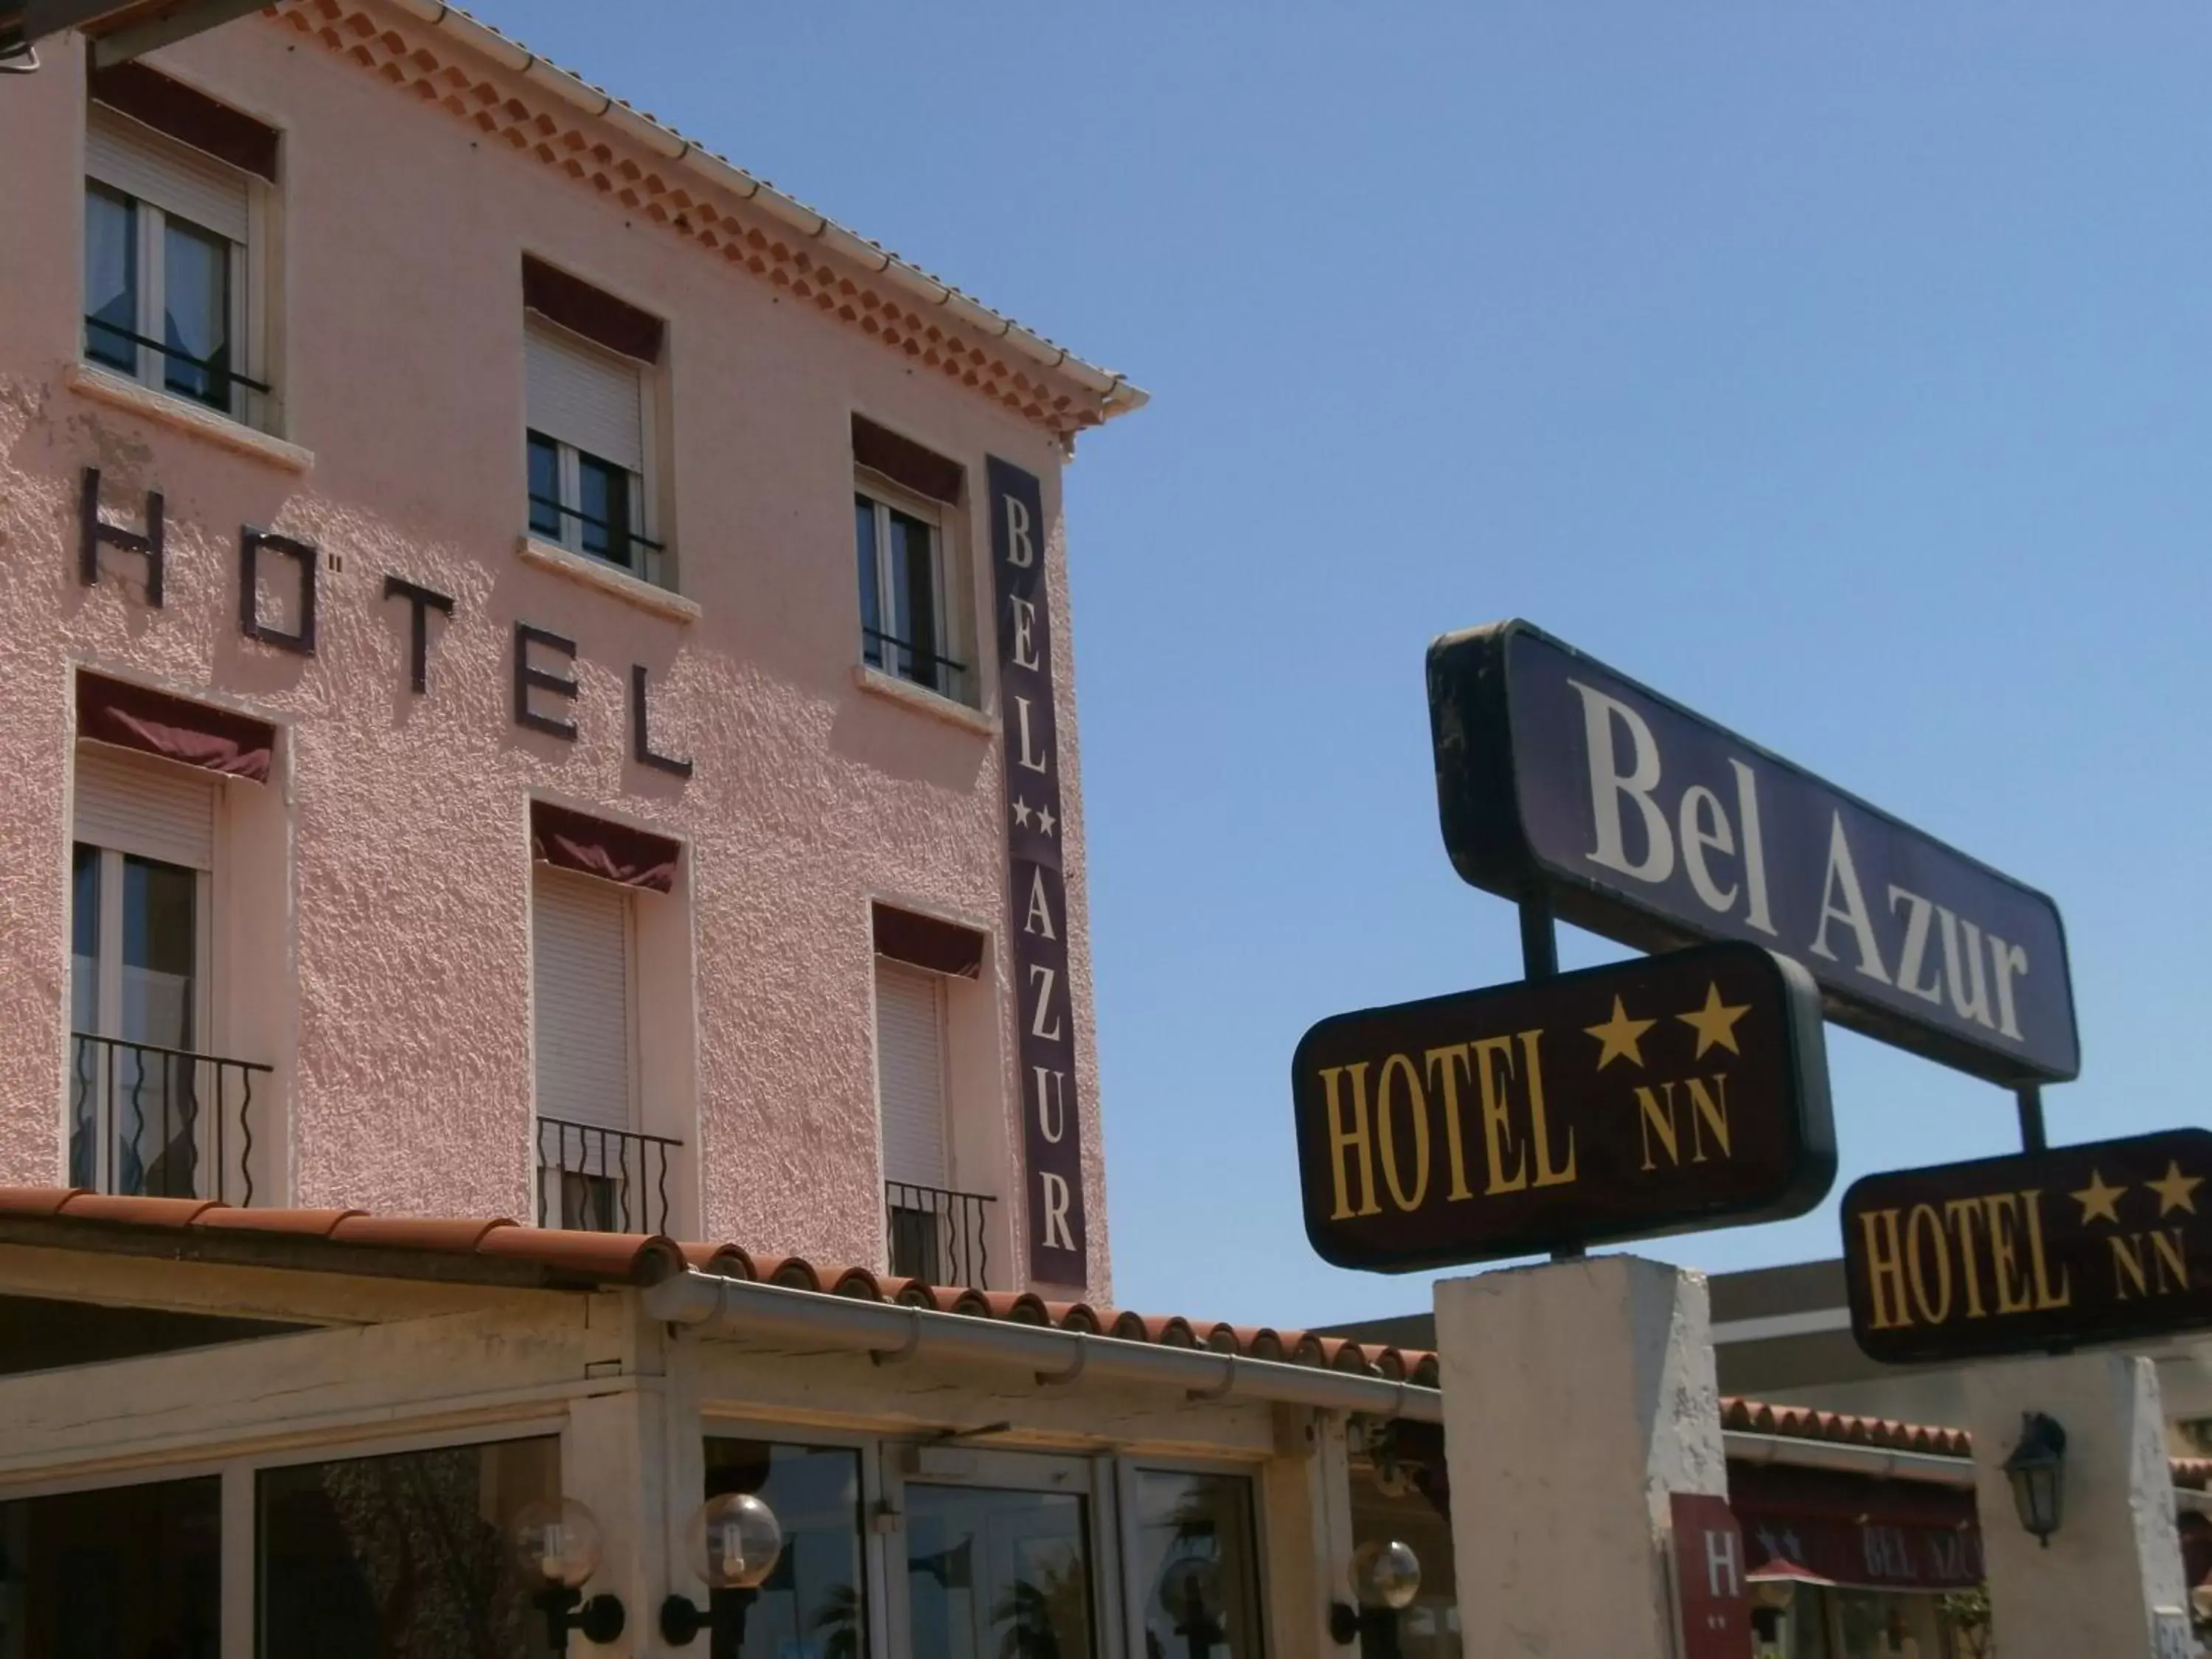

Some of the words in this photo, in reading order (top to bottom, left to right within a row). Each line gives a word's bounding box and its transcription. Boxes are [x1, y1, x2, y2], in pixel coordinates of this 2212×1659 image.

[80, 466, 692, 777] HOTEL
[1002, 493, 1046, 774] BEL
[1024, 863, 1077, 1251] AZUR
[1567, 678, 1778, 936] Bel
[1810, 809, 2028, 1042] Azur
[1318, 1029, 1576, 1220] HOTEL
[1633, 1074, 1731, 1171] NN
[1860, 1189, 2070, 1328] HOTEL
[2107, 1227, 2188, 1299] NN
[1704, 1529, 1739, 1598] H
[1863, 1525, 1917, 1578] BEL
